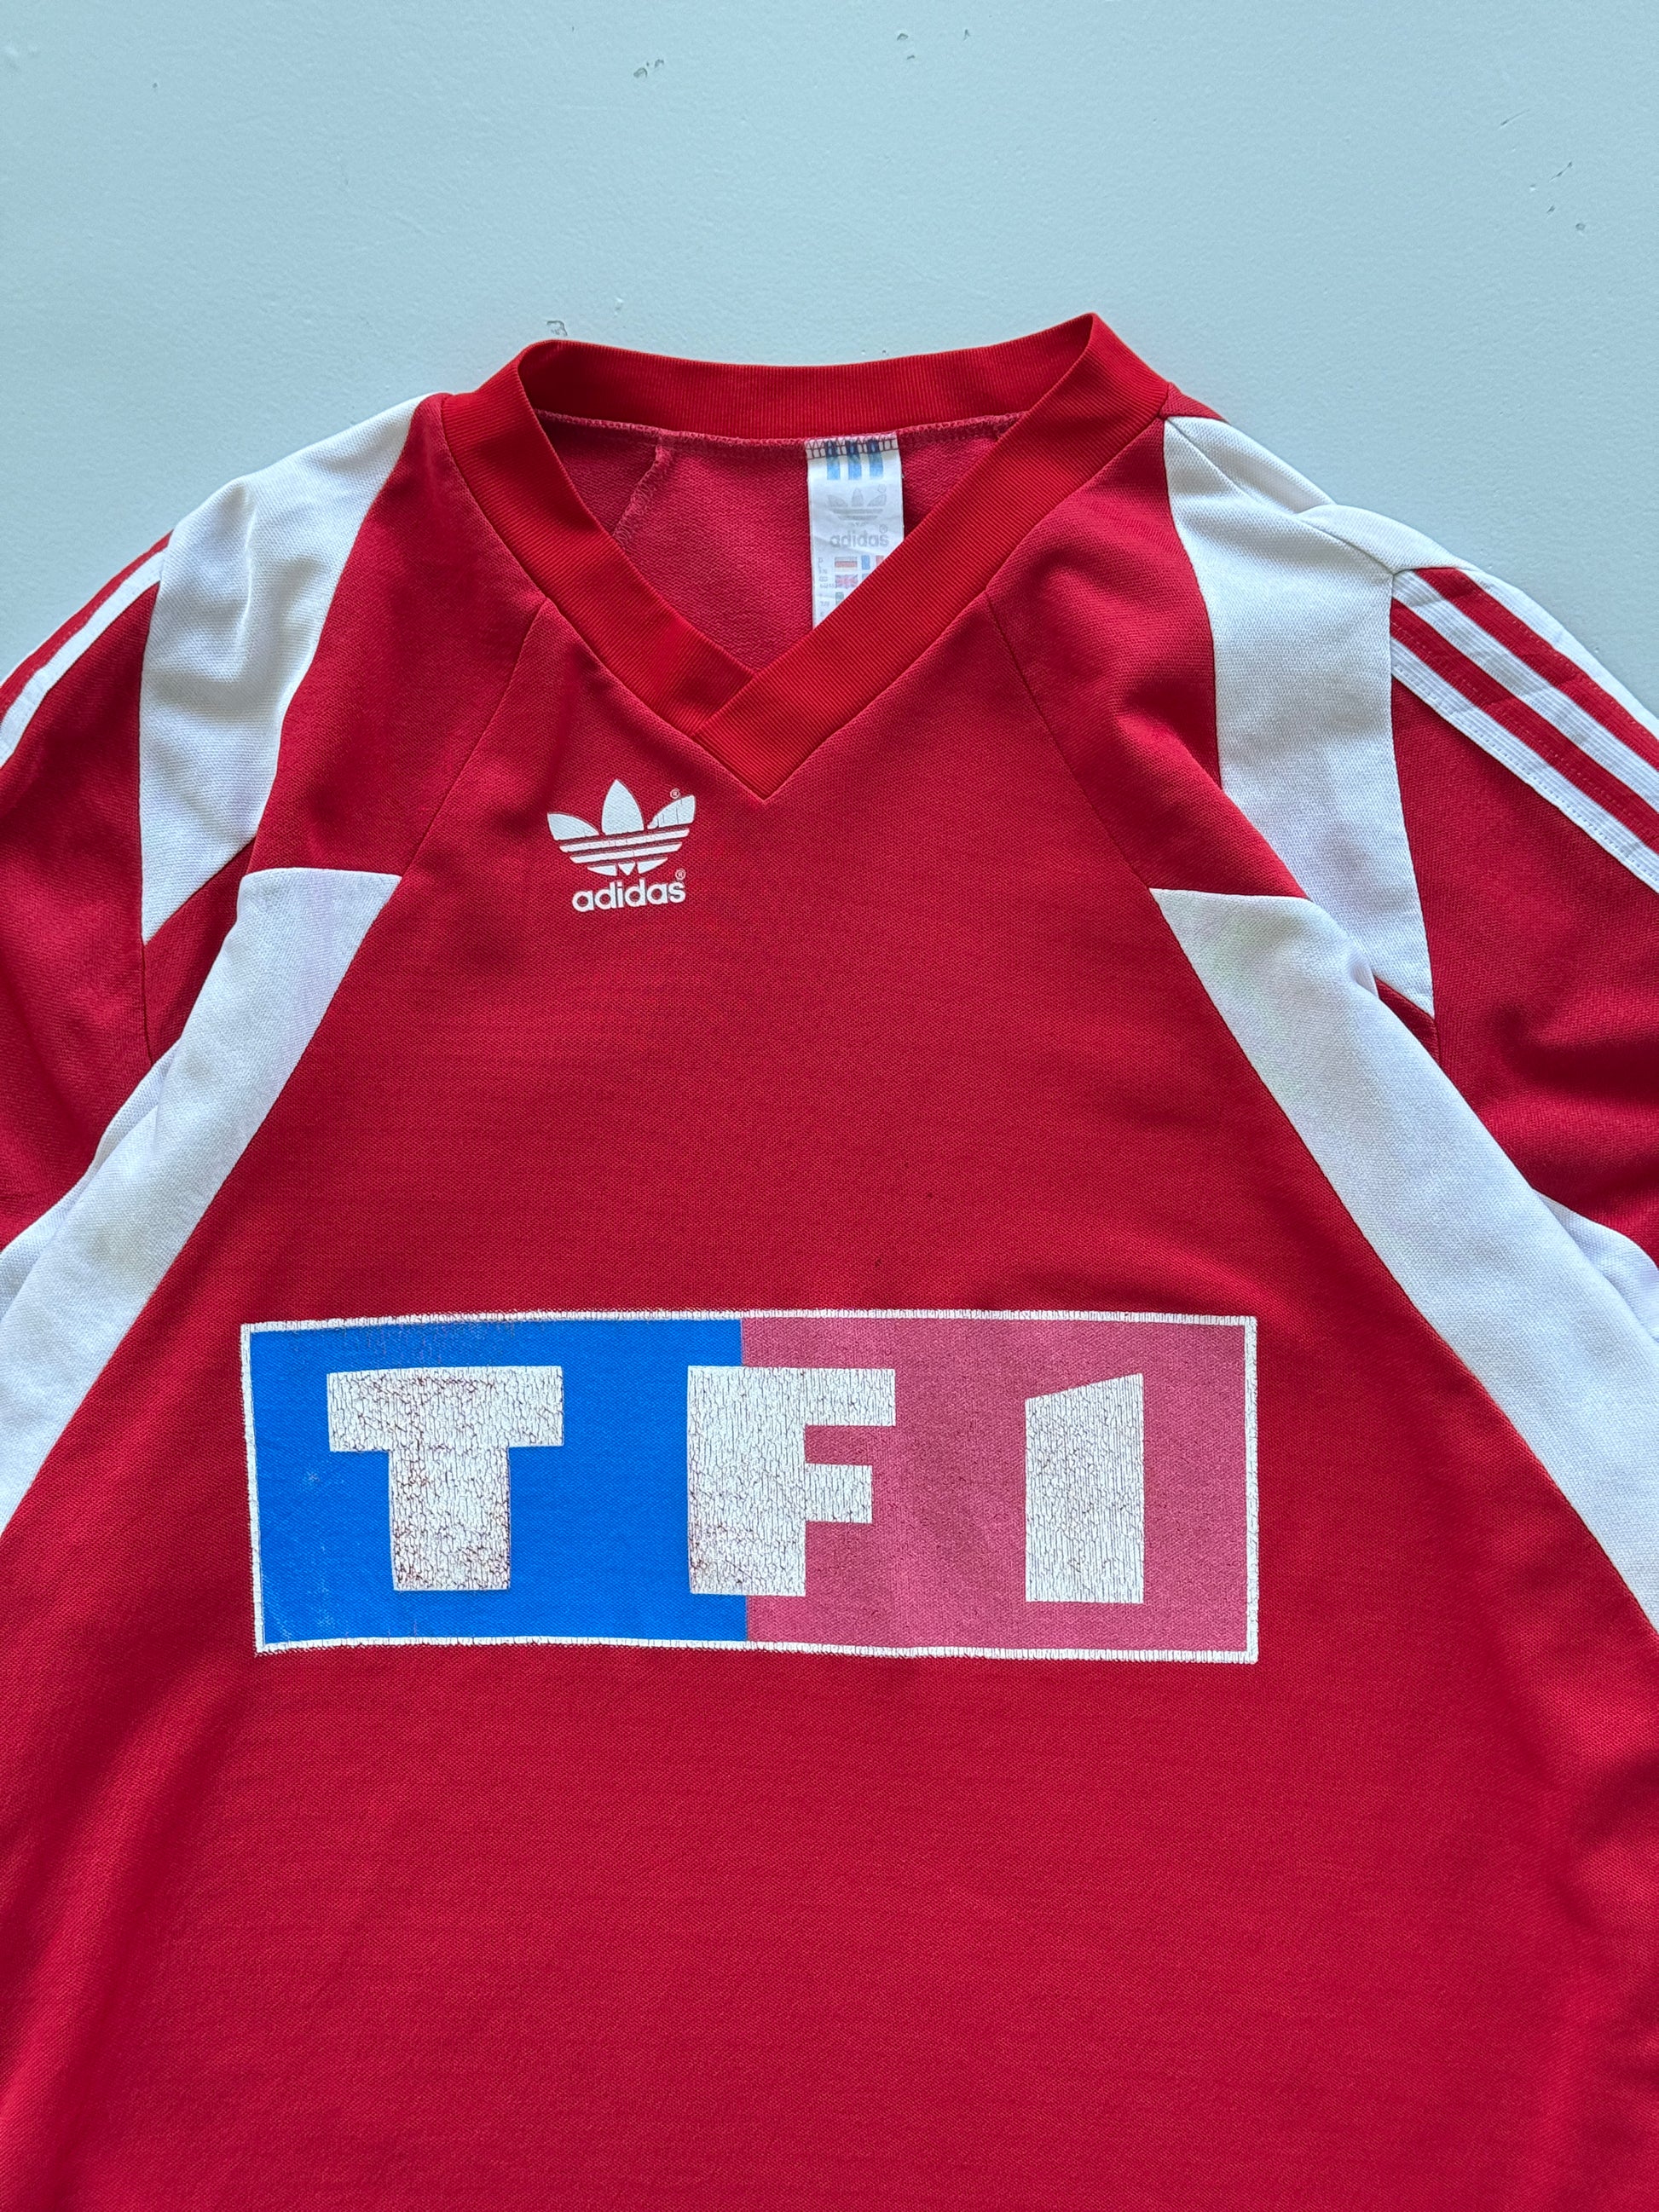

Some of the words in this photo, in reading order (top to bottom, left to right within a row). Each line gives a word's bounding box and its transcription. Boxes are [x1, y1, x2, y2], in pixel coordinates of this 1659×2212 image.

[830, 530, 889, 548] adidas
[572, 879, 685, 912] adidas
[327, 1366, 1144, 1603] TF1
